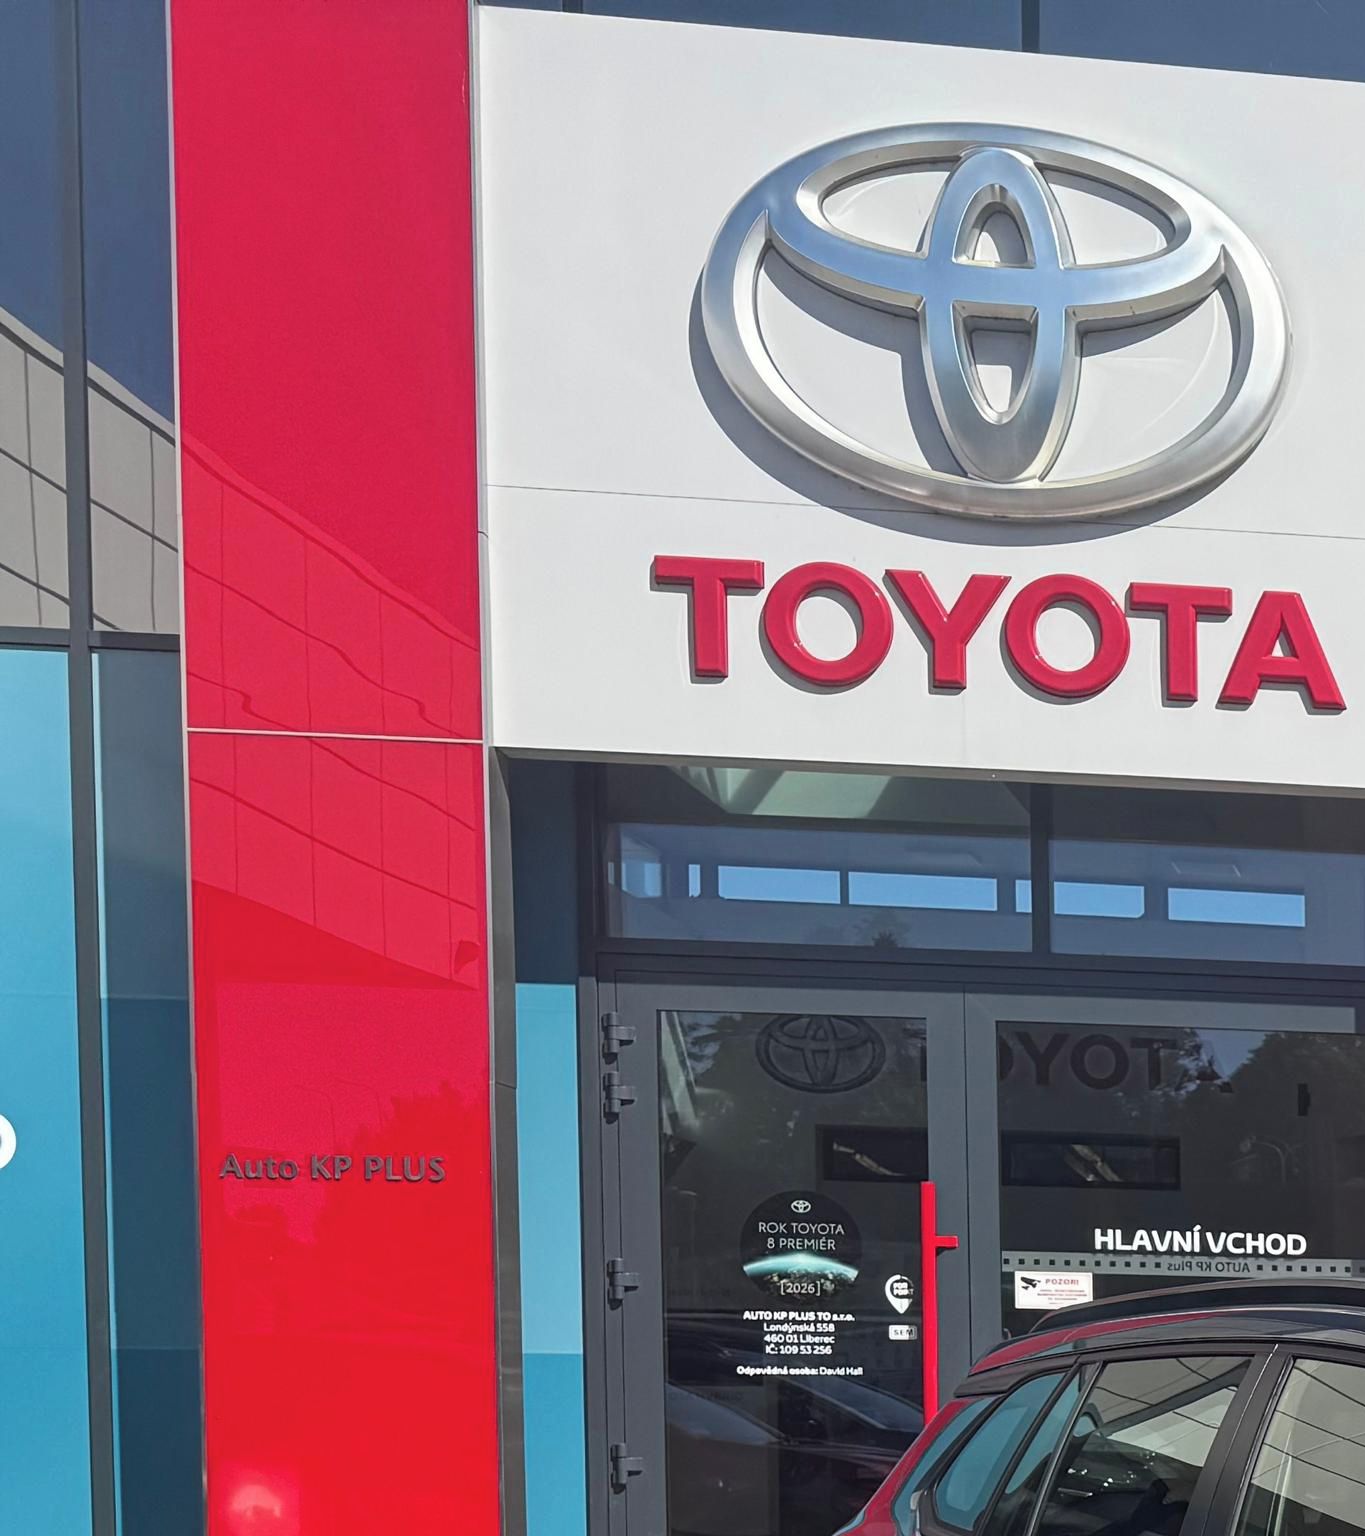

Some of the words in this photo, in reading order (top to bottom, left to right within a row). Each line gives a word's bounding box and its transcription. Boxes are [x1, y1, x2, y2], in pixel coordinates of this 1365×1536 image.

[653, 554, 1347, 712] TOYOTA
[219, 1153, 298, 1180] Auto
[310, 1154, 353, 1181] KP
[364, 1155, 446, 1182] PLUS
[758, 1222, 788, 1234] ROK
[790, 1222, 845, 1235] TOYOTA
[766, 1238, 775, 1249] 8
[779, 1236, 836, 1251] PREMIÉR
[1094, 1224, 1201, 1253] HLAVNÍ
[1205, 1232, 1307, 1256] VCHOD
[780, 1281, 821, 1296] [2026]
[742, 1310, 772, 1320] AUTO
[774, 1311, 788, 1320] KP
[788, 1311, 816, 1321] PLUS
[816, 1312, 831, 1321] TO
[763, 1322, 815, 1333] Londýnská
[763, 1334, 784, 1343] 460
[786, 1334, 798, 1343] 01
[800, 1334, 835, 1344] Liberec
[819, 1366, 845, 1376] David
